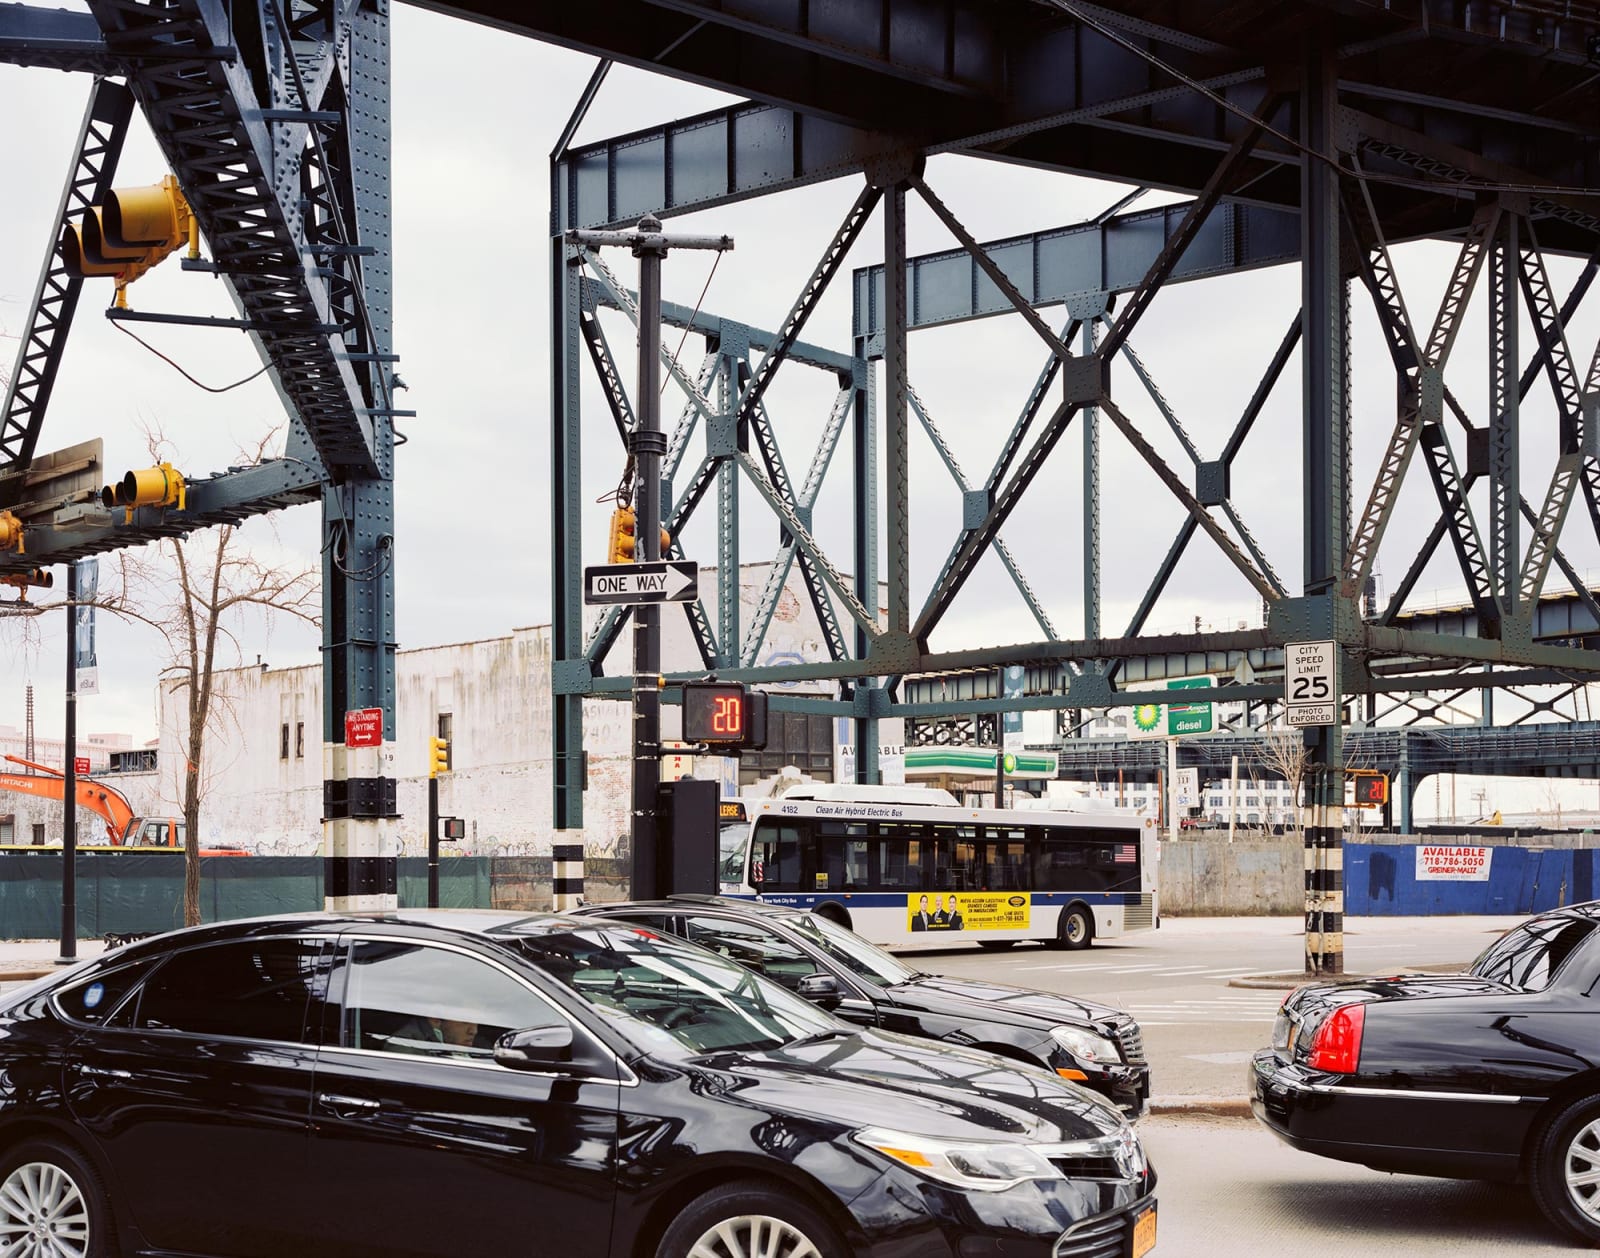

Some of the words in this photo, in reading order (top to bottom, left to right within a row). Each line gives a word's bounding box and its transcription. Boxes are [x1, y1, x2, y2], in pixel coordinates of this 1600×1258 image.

[597, 576, 627, 592] ONE
[636, 575, 667, 591] WAY
[1299, 646, 1319, 654] CITY
[1295, 656, 1324, 664] SPEED
[1293, 676, 1329, 699] 25
[713, 697, 741, 732] 20
[1290, 714, 1331, 722] ENFORCED
[352, 723, 376, 732] ANYTIME
[1176, 720, 1202, 730] diesel
[842, 746, 905, 755] AVABLE
[0, 777, 33, 788] HITACHI
[781, 805, 798, 814] 4182
[815, 806, 833, 814] Clean
[834, 806, 845, 815] Air
[846, 806, 866, 816] Hybrid
[867, 806, 890, 817] Electric
[891, 808, 903, 817] Bus
[1423, 847, 1486, 856] AVAILABLE
[1424, 857, 1484, 866] 718-786-5050
